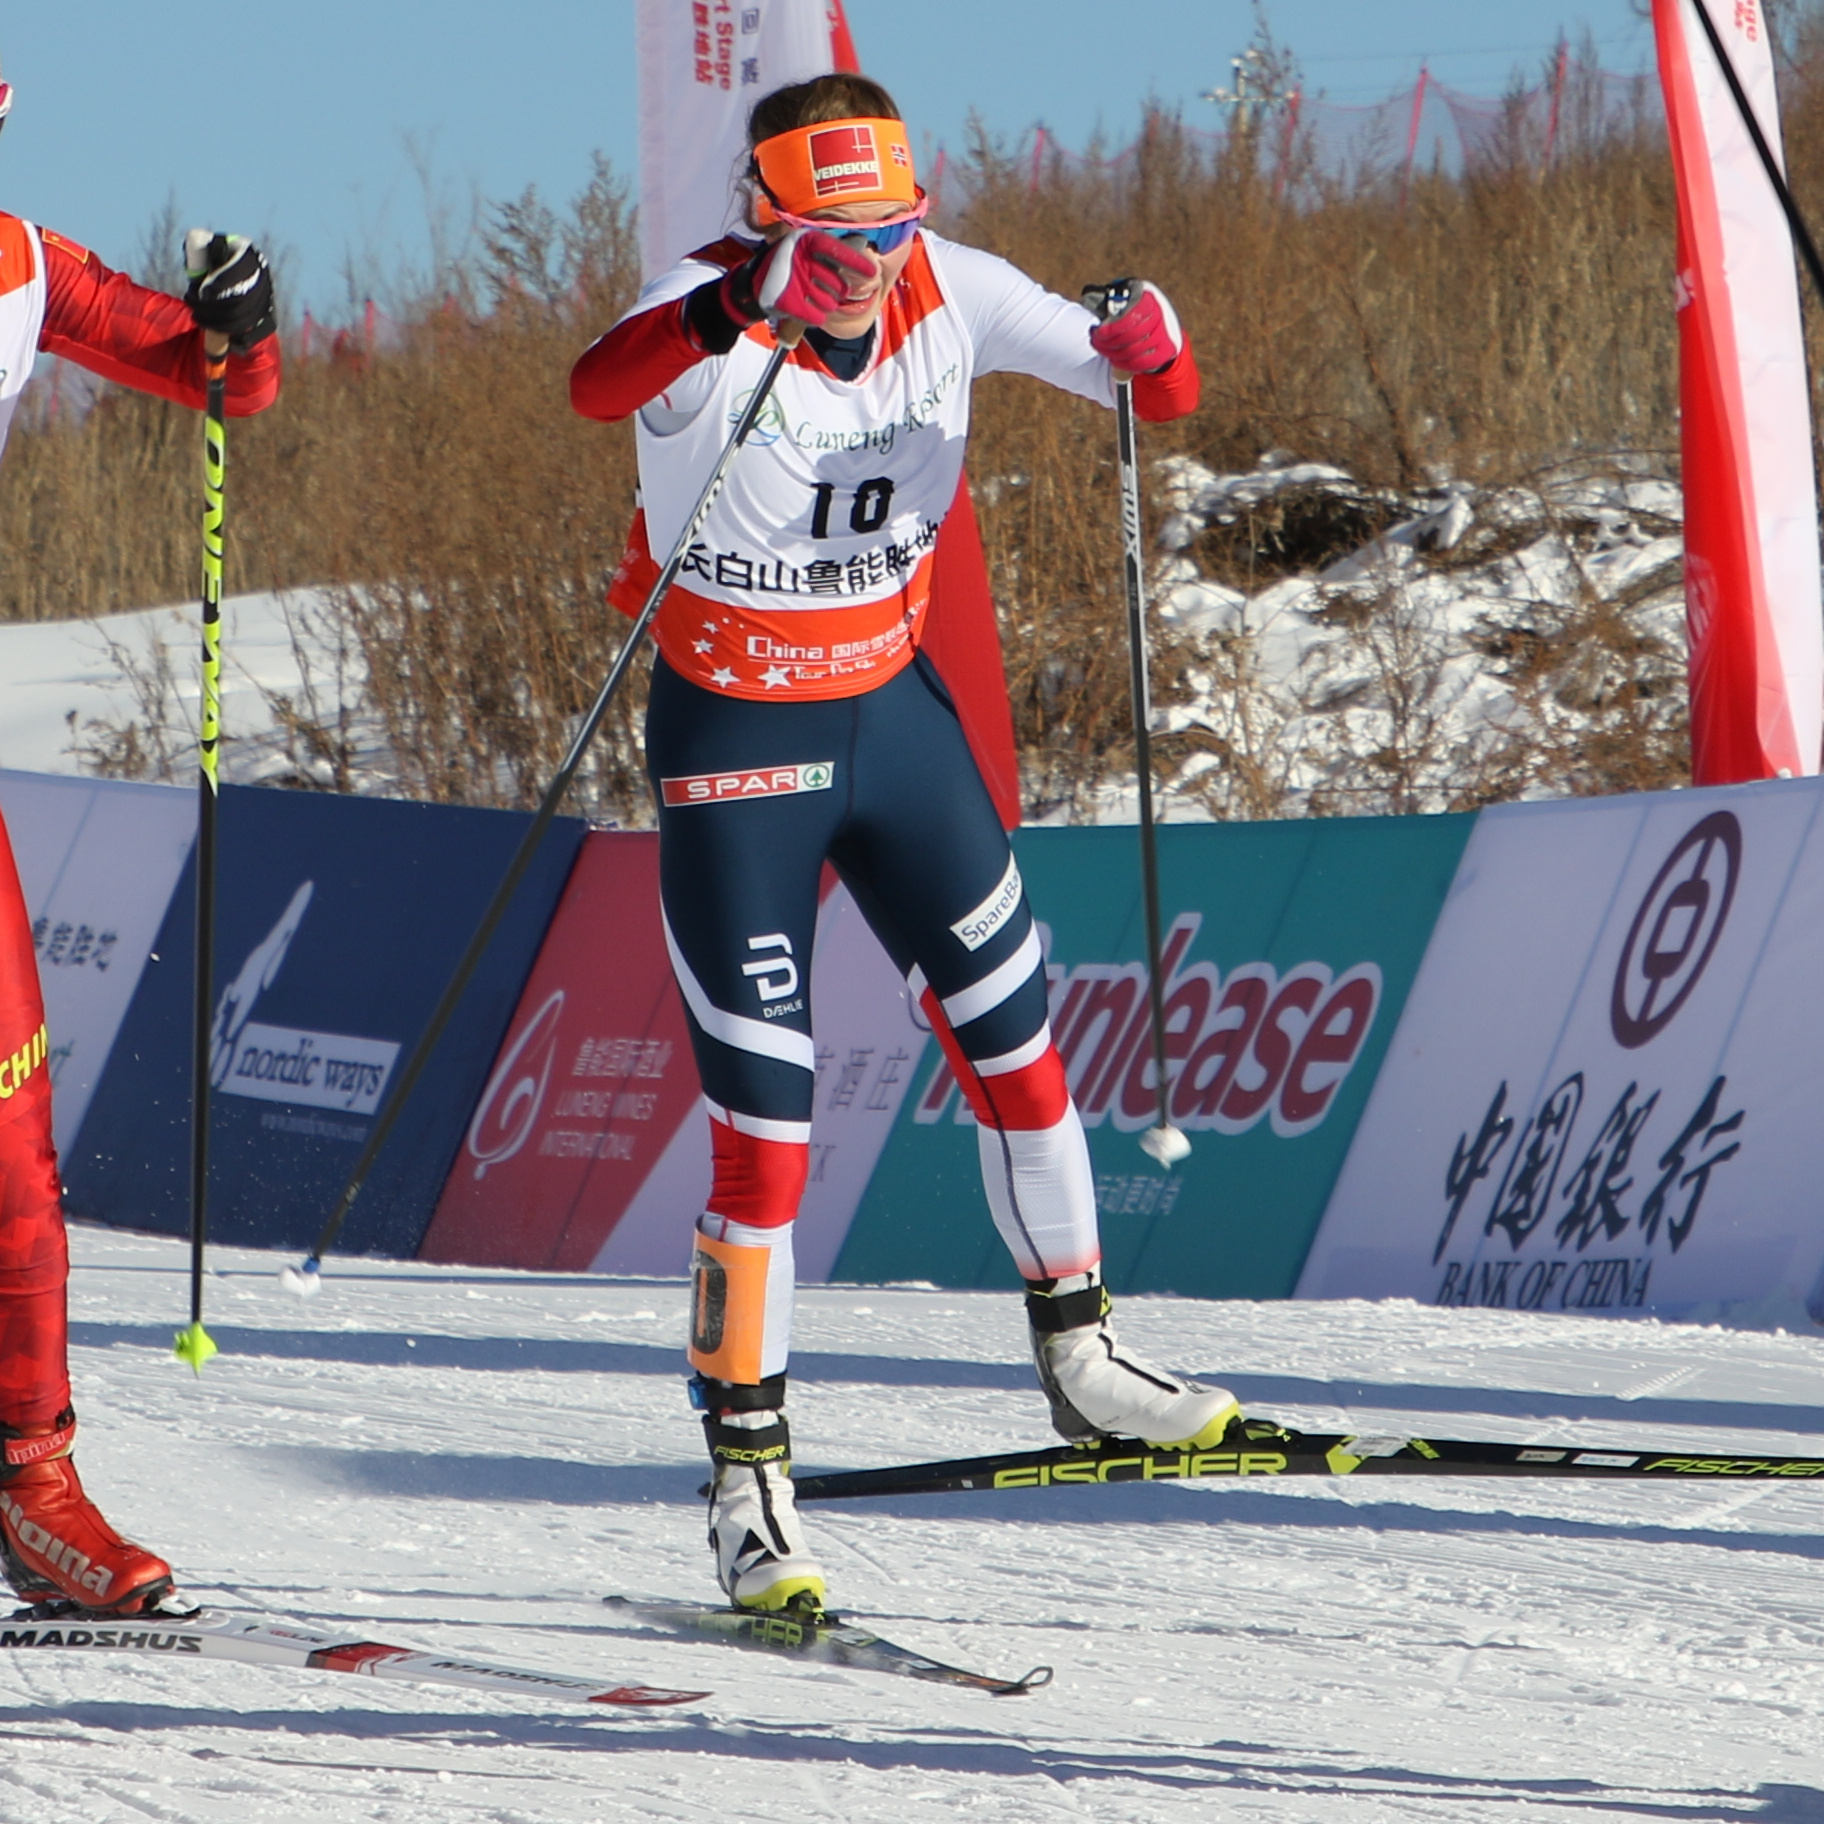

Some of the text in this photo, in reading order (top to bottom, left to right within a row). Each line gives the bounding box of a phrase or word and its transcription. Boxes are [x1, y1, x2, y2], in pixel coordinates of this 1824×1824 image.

[714, 22, 734, 92] Stage
[812, 160, 880, 182] VEIDEKKE
[794, 420, 897, 455] Luneng
[810, 477, 895, 539] 10
[746, 636, 825, 661] China
[792, 666, 828, 681] Tour
[685, 766, 798, 802] SPAR
[236, 1036, 386, 1109] nordic ways
[553, 1090, 659, 1121] LUNENG WINES
[537, 1129, 636, 1161] INTERNATIONAL
[1432, 1070, 1747, 1269] 中国银行
[1436, 1258, 1653, 1310] BANK OF CHINA
[713, 1443, 787, 1463] FISCHER
[992, 1451, 1288, 1491] FISCHER
